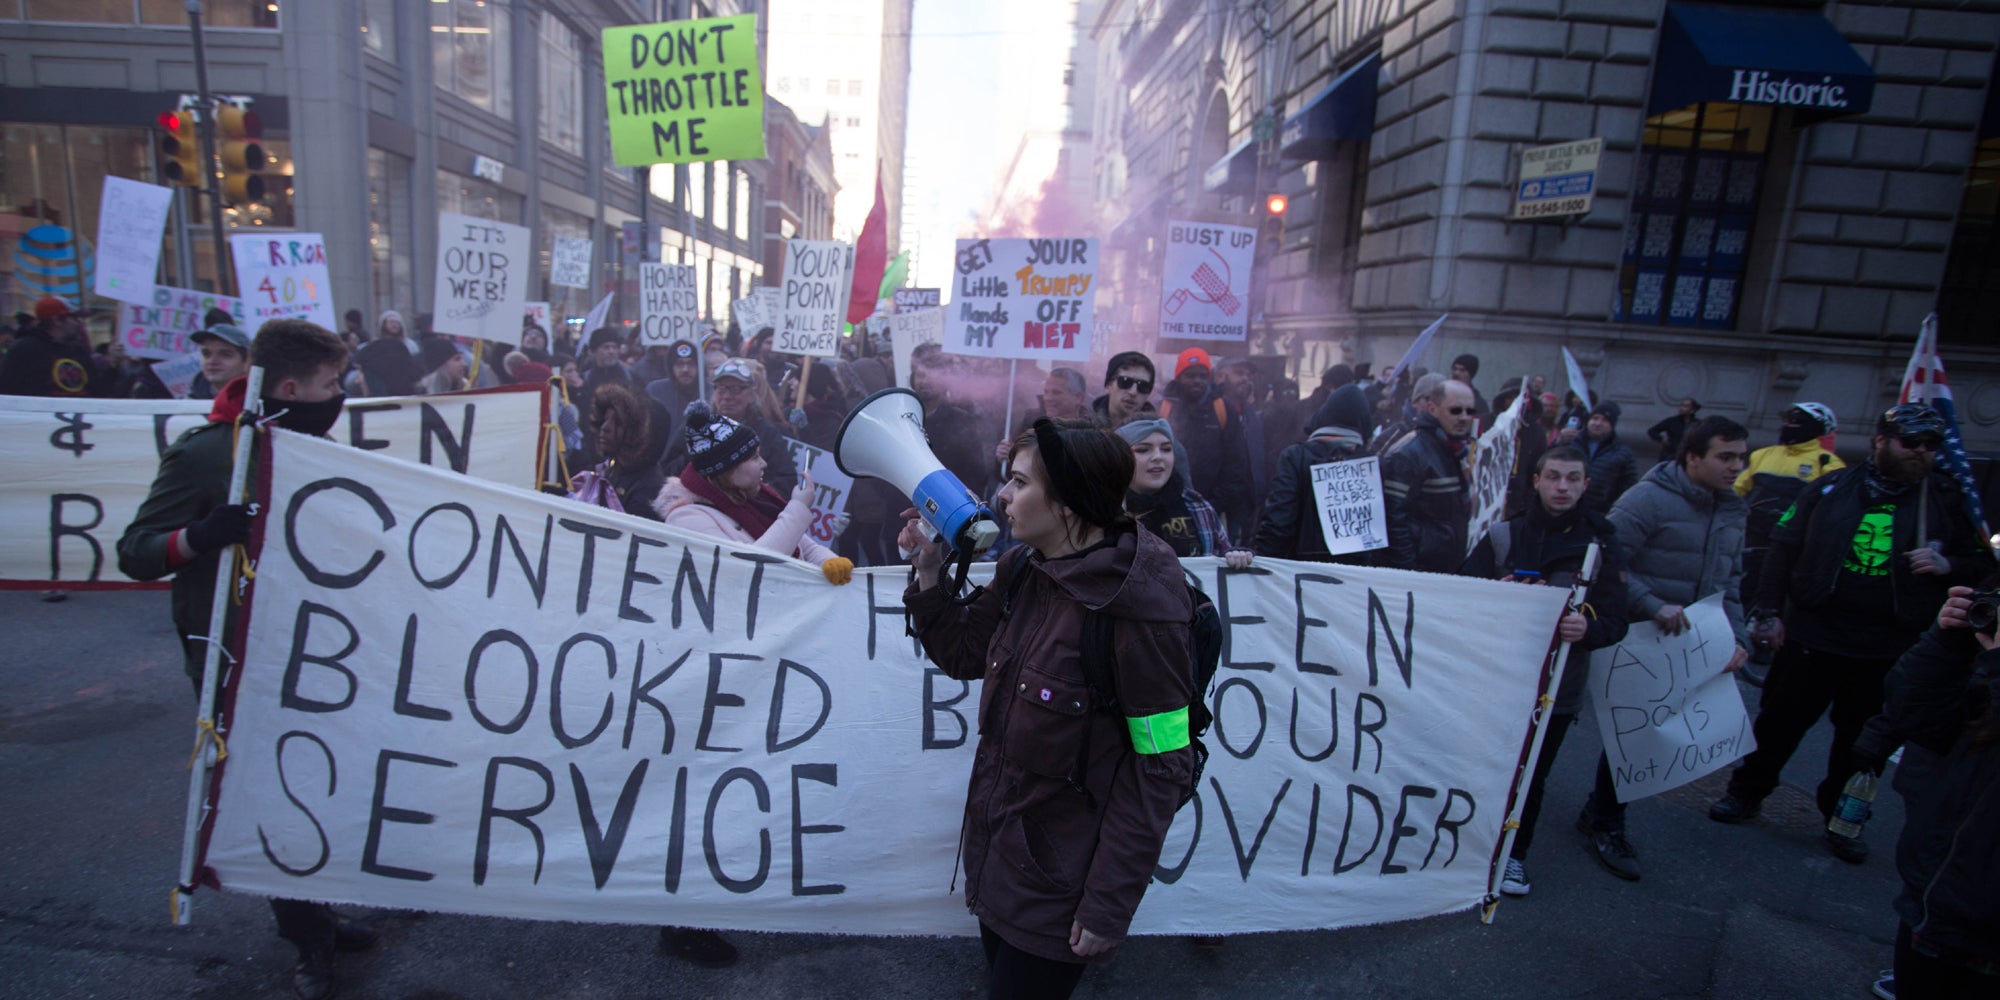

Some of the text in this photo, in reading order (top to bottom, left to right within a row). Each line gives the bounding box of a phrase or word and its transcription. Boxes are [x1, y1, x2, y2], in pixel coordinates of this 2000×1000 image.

[631, 24, 734, 69] DON'T
[611, 69, 749, 115] THROTTLE
[1728, 69, 1848, 108] Historic.
[652, 118, 709, 157] ME
[1520, 199, 1585, 216] 215-545-1500
[1171, 225, 1253, 249] BUST UP
[244, 240, 326, 267] ERROR
[445, 247, 508, 281] OUR
[791, 243, 840, 277] YOUR
[956, 238, 1087, 275] GET YOUR
[258, 275, 316, 304] 404
[447, 276, 507, 301] WEB!
[785, 279, 837, 310] PORN
[895, 290, 938, 306] SAVE
[960, 275, 1009, 297] Little
[646, 290, 698, 312] HARD
[960, 299, 1082, 325] Hands OFF
[644, 314, 697, 341] COPY
[784, 313, 837, 332] WILL BE
[964, 324, 999, 348] MY
[1024, 321, 1081, 349] NET
[1163, 322, 1243, 335] THE TELECOMS
[779, 332, 834, 351] SLOWER
[787, 441, 822, 470] ET
[1314, 460, 1377, 483] INTERNET
[1328, 479, 1369, 495] ACCESS
[1328, 503, 1372, 523] HUMAN
[1332, 517, 1374, 539] RIGHT
[284, 476, 785, 641] CONTENT
[1185, 566, 1415, 689] EEN
[1605, 623, 1711, 703] Ajit
[281, 600, 1388, 774] BLOCKED B OUR
[1616, 760, 1659, 787] Not
[257, 730, 1477, 897] SERVICE OVIDER
